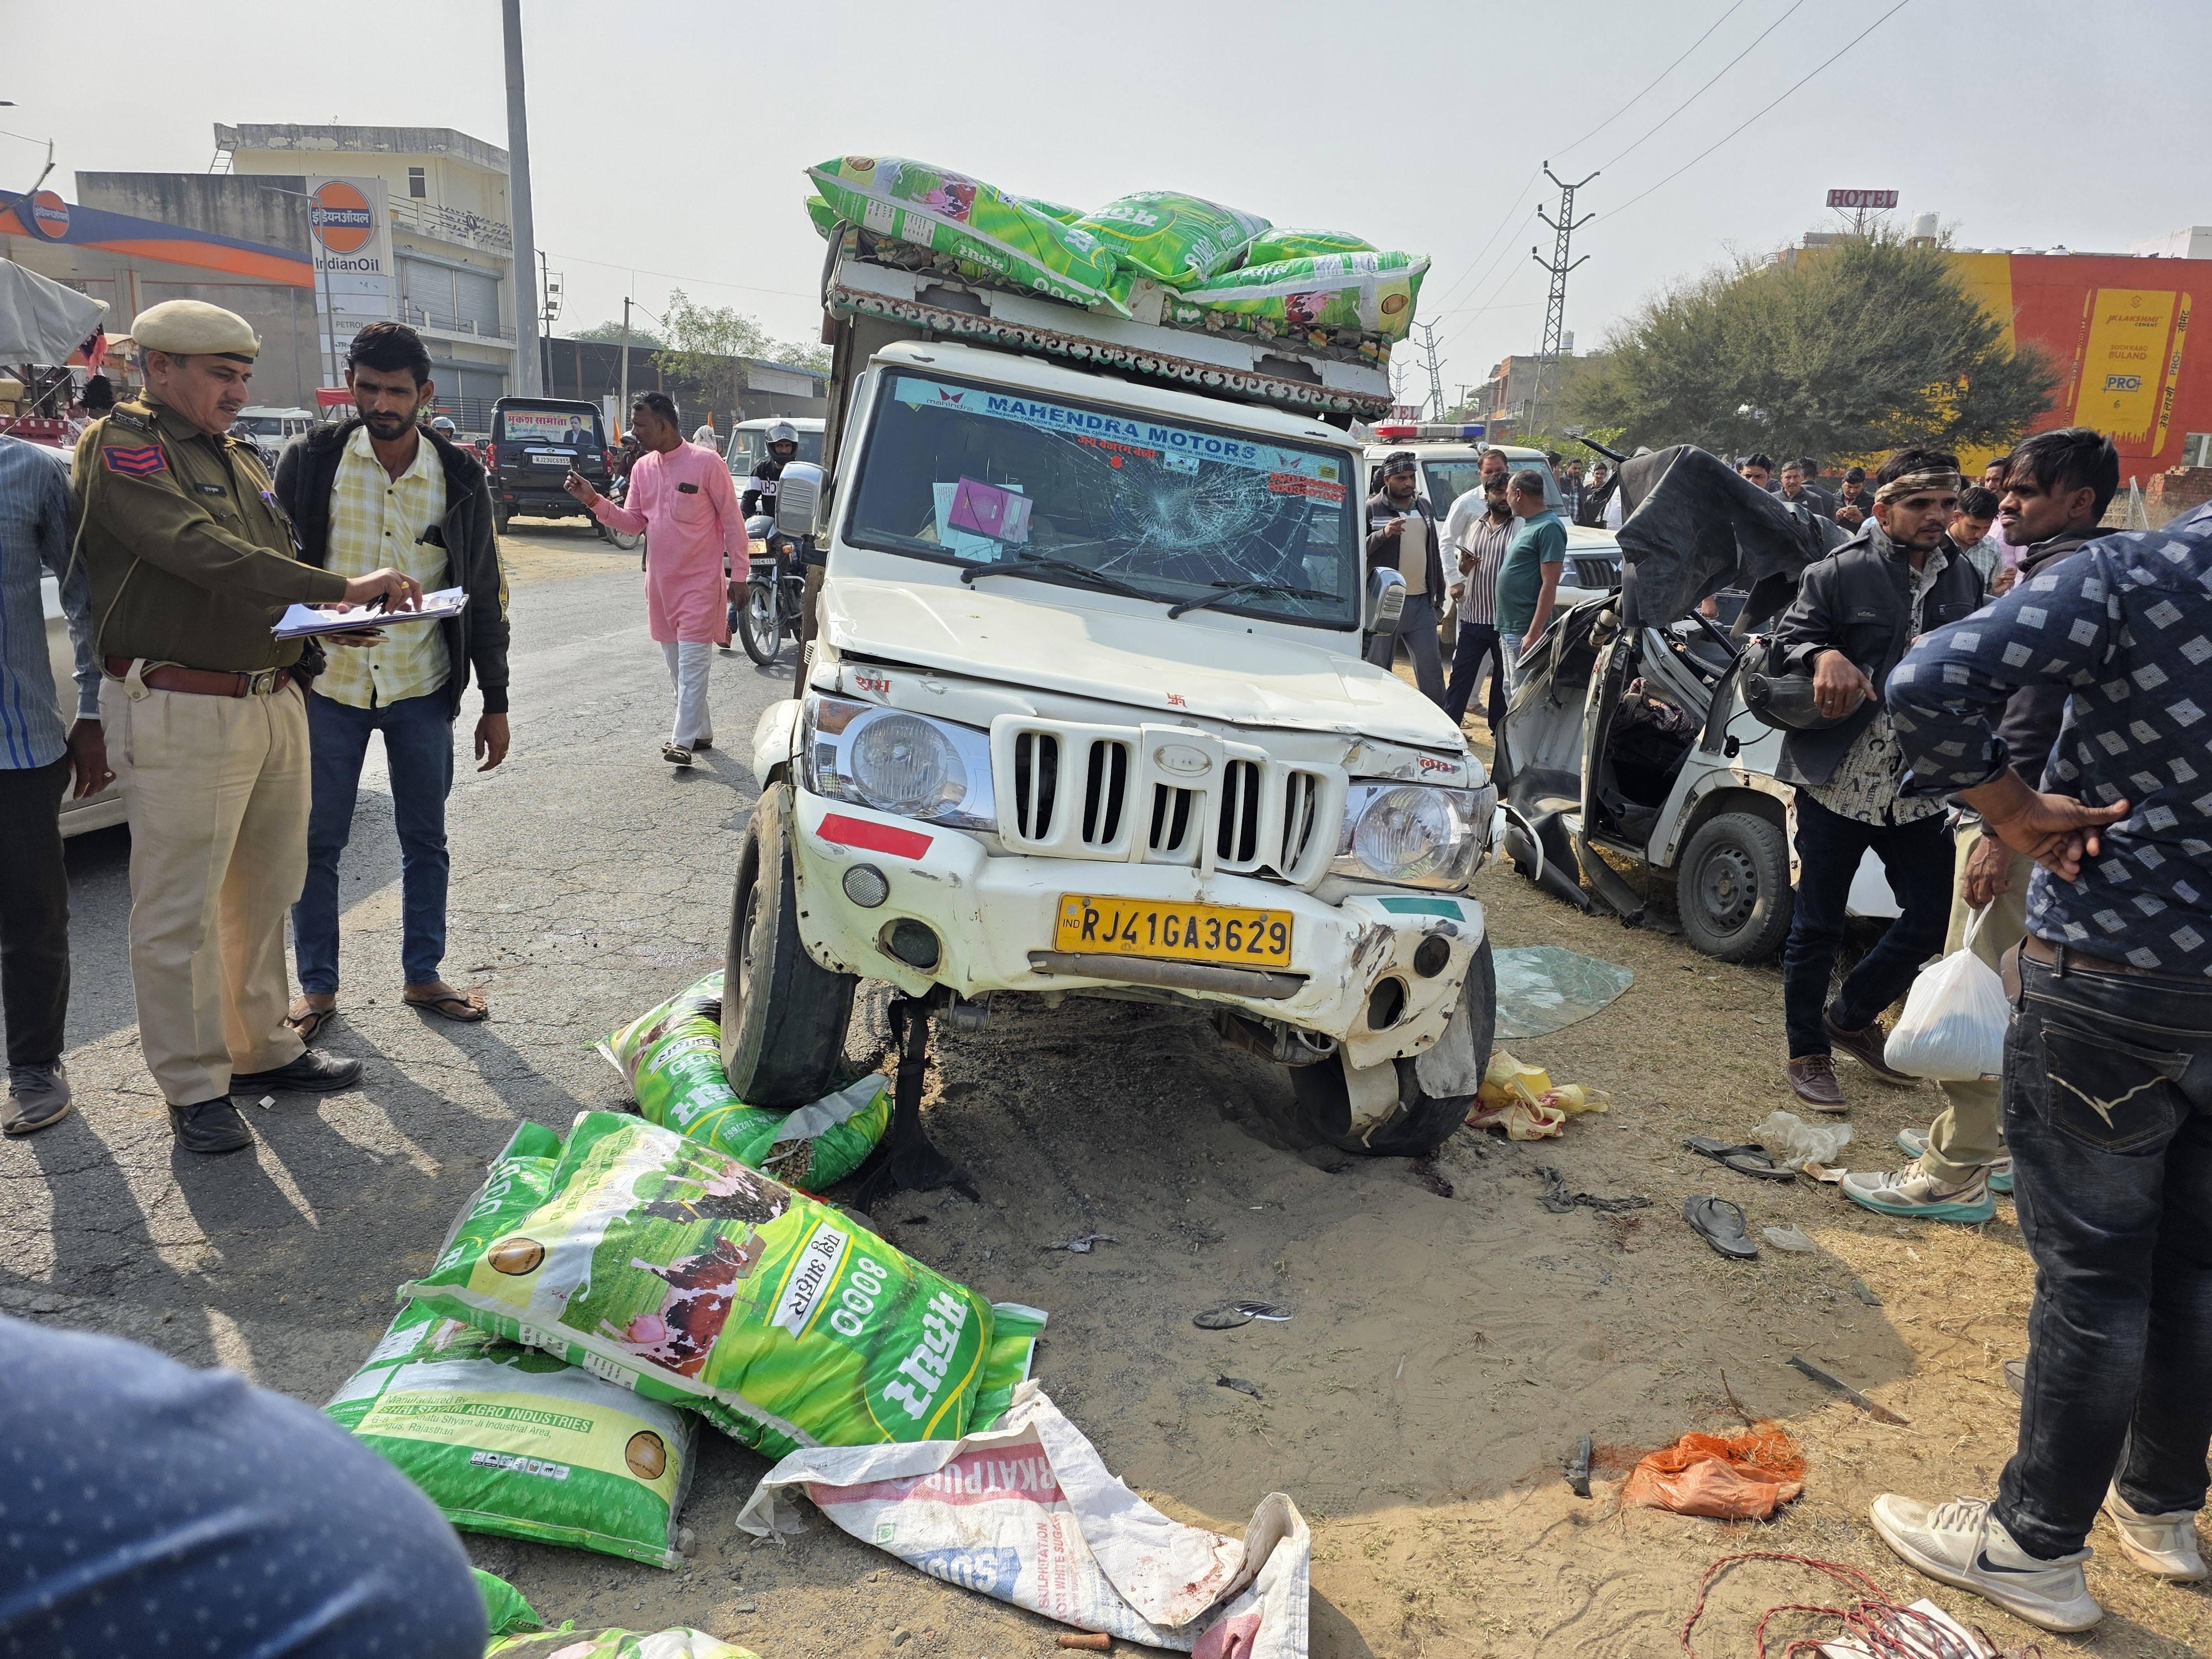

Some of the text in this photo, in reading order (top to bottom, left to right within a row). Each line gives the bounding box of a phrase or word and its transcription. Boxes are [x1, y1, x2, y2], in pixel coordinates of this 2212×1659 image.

[1828, 190, 1897, 207] HOTEL
[315, 257, 379, 271] IndianOil
[336, 321, 364, 329] PETROL
[2109, 351, 2147, 360] BULAND
[2169, 349, 2181, 376] PRO+
[2107, 377, 2143, 389] PRO+
[926, 399, 973, 411] mahindra
[1391, 405, 1420, 420] TEL
[507, 414, 567, 426] मुकेश सामोता
[988, 396, 1256, 460] MAHENDRA MOTORS
[1077, 435, 1097, 448] जय
[1112, 434, 1130, 442] (SHOP)
[1168, 445, 1187, 454] CHOMU
[1062, 917, 1081, 929] IND
[1081, 907, 1286, 955] RJ41GA3629
[789, 1234, 841, 1320] पशु आहार
[830, 1257, 889, 1337] 8000
[882, 1291, 968, 1421] मरुधर
[385, 1395, 468, 1407] Manufactured By
[382, 1404, 592, 1433] SHRI SHYAM AGRO INDUSTRIES
[408, 1423, 454, 1436] Rajasthan
[442, 1415, 473, 1428] Shyam
[475, 1418, 484, 1428] Ji
[486, 1420, 528, 1433] Industrial
[529, 1426, 552, 1439] Area,
[628, 1458, 641, 1468] When
[1052, 1512, 1065, 1553] SUGAR
[1054, 1555, 1066, 1590] WHITE
